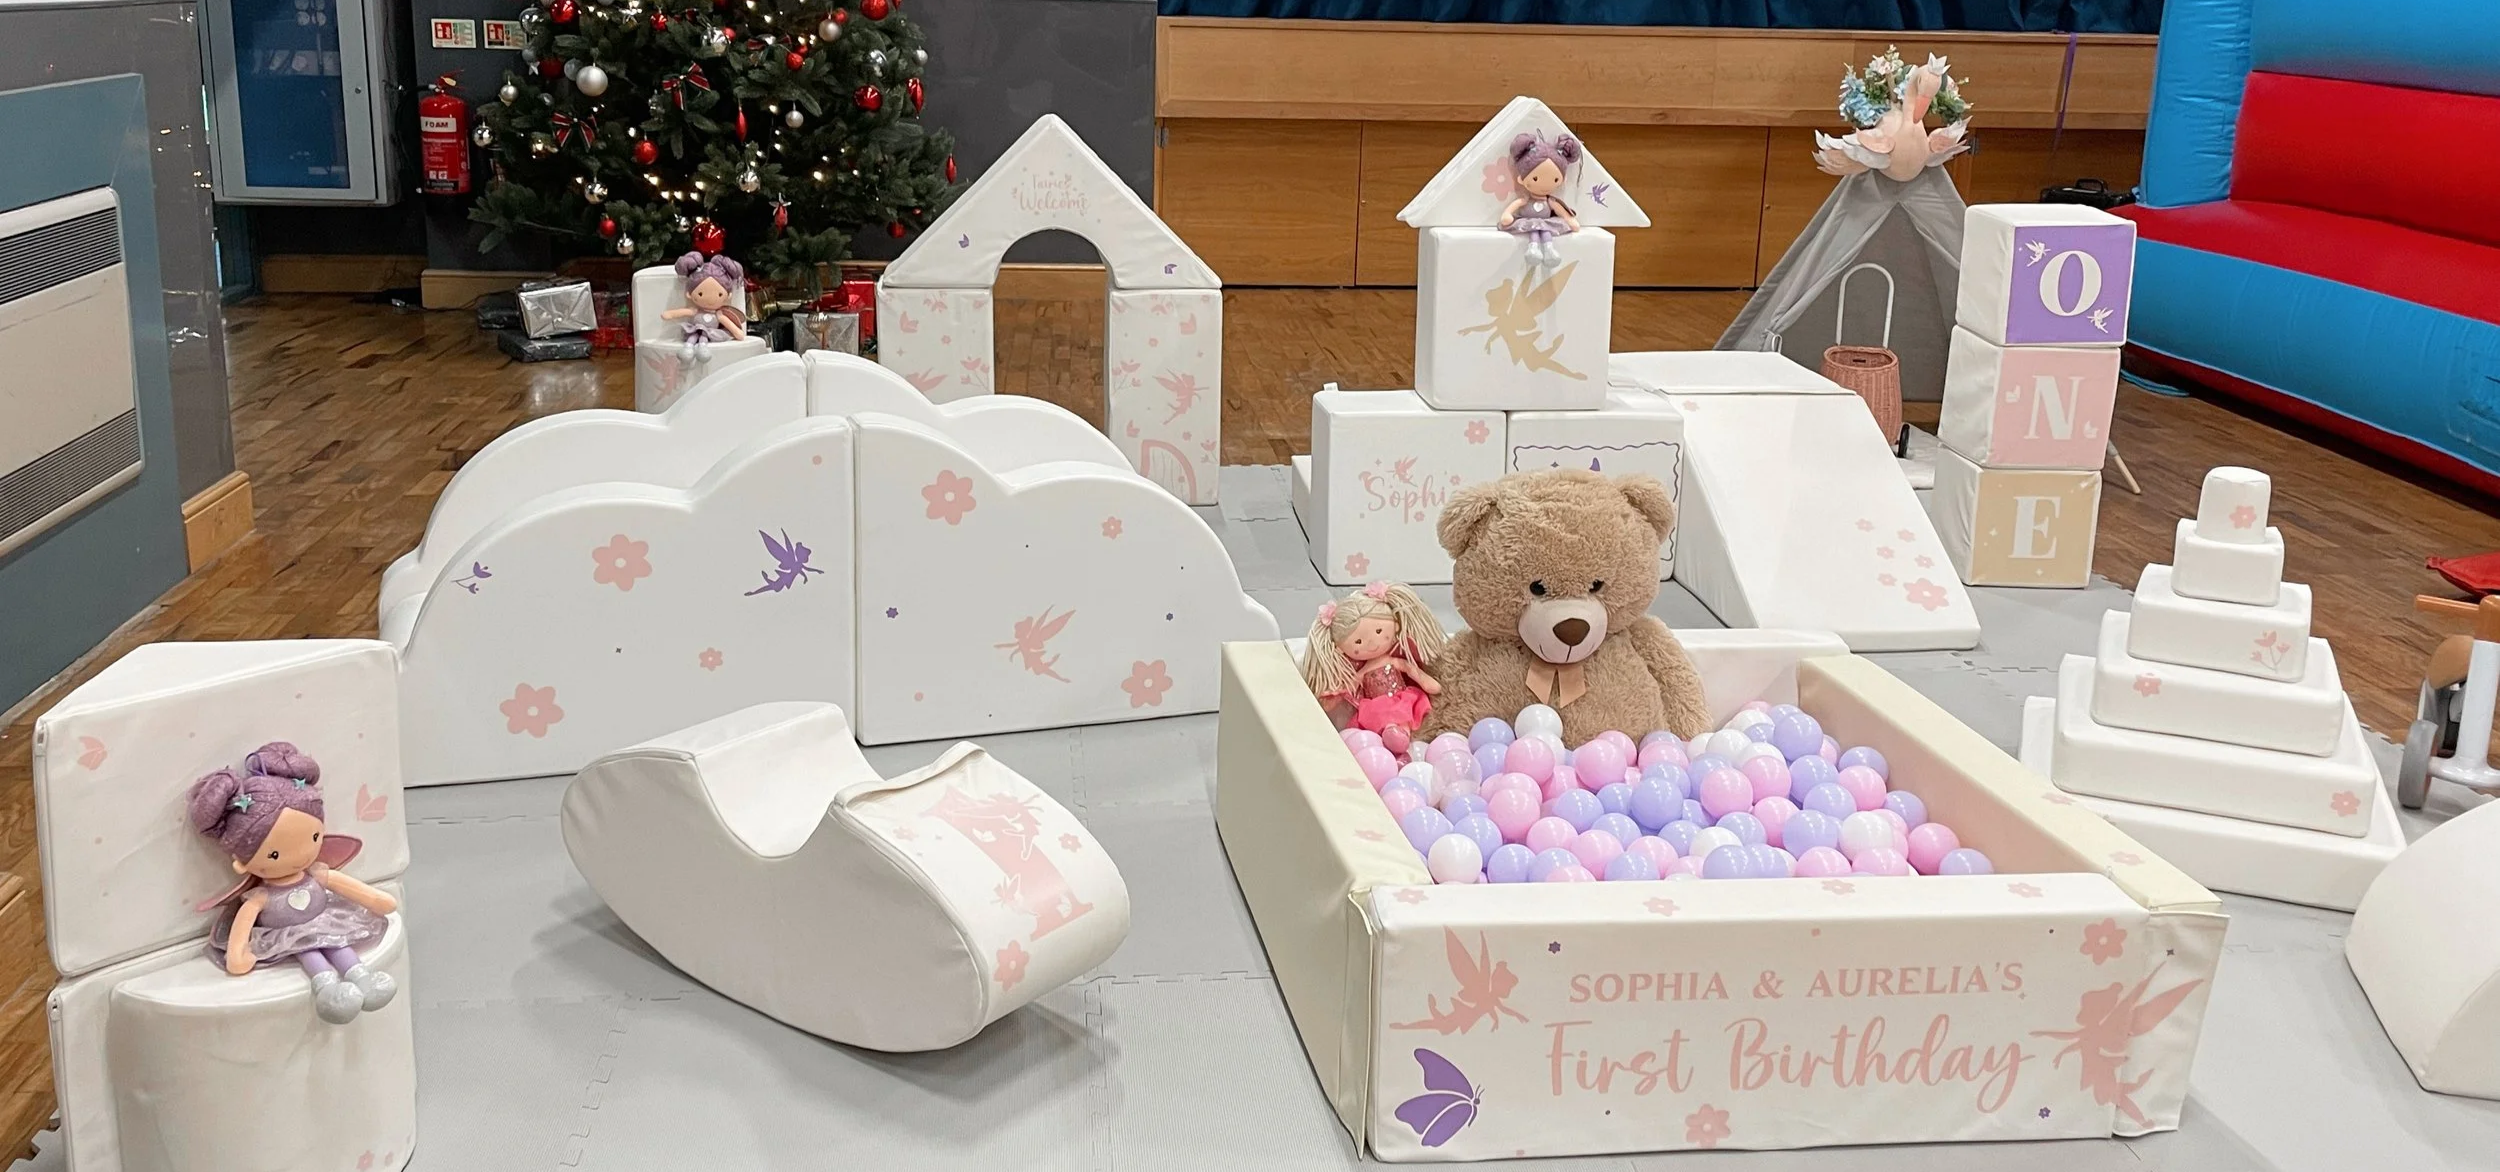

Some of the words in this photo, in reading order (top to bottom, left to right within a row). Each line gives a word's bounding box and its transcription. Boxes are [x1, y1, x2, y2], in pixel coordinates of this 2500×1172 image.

[1359, 471, 1447, 524] Sophi
[1569, 972, 1729, 1003] SOPHIA
[1753, 970, 1784, 999] &
[1805, 962, 2023, 998] AURELIA'S
[1544, 1020, 1694, 1096] First
[1724, 1014, 2036, 1113] Birthday
